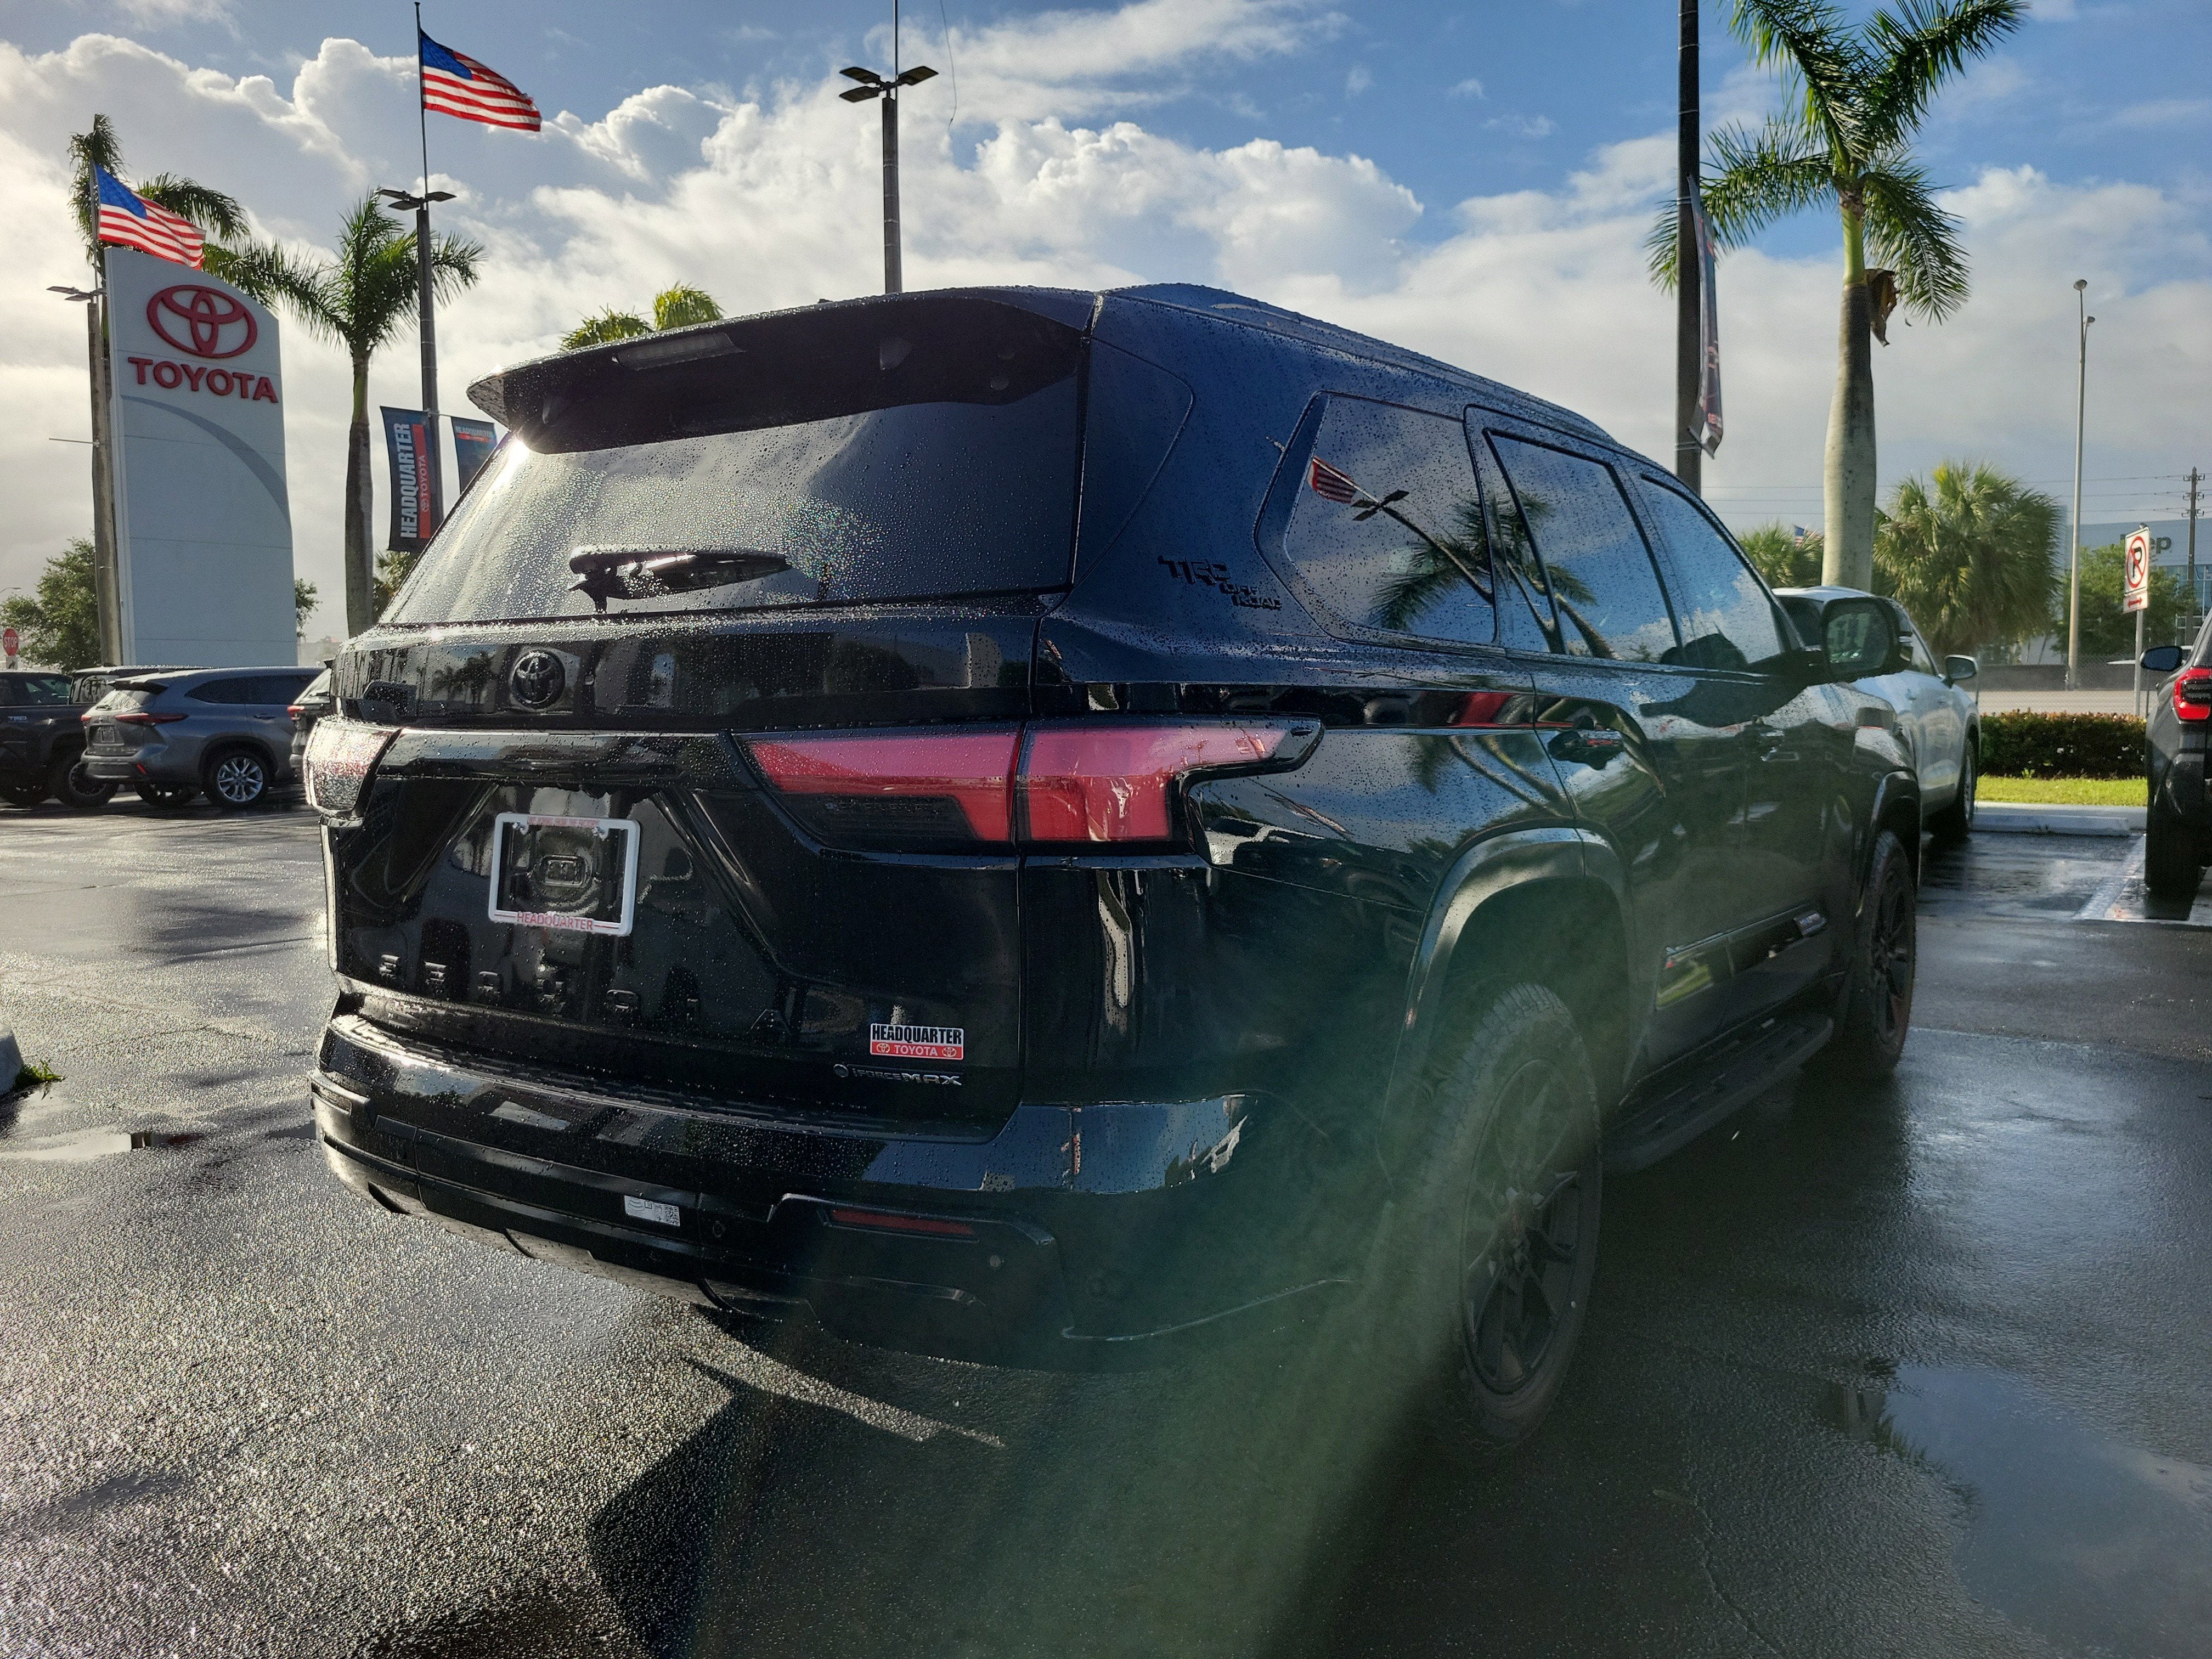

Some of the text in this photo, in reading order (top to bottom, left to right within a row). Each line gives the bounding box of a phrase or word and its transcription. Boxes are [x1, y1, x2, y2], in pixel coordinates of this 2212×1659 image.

[128, 357, 278, 403] TOYOTA
[394, 423, 419, 538] HEADQUARTER
[419, 455, 428, 496] TOYOTA
[4, 637, 18, 648] STOP
[517, 911, 593, 930] HEADQUARTER
[872, 1024, 962, 1045] HEADQUARTER
[894, 1044, 938, 1057] TOYOTA
